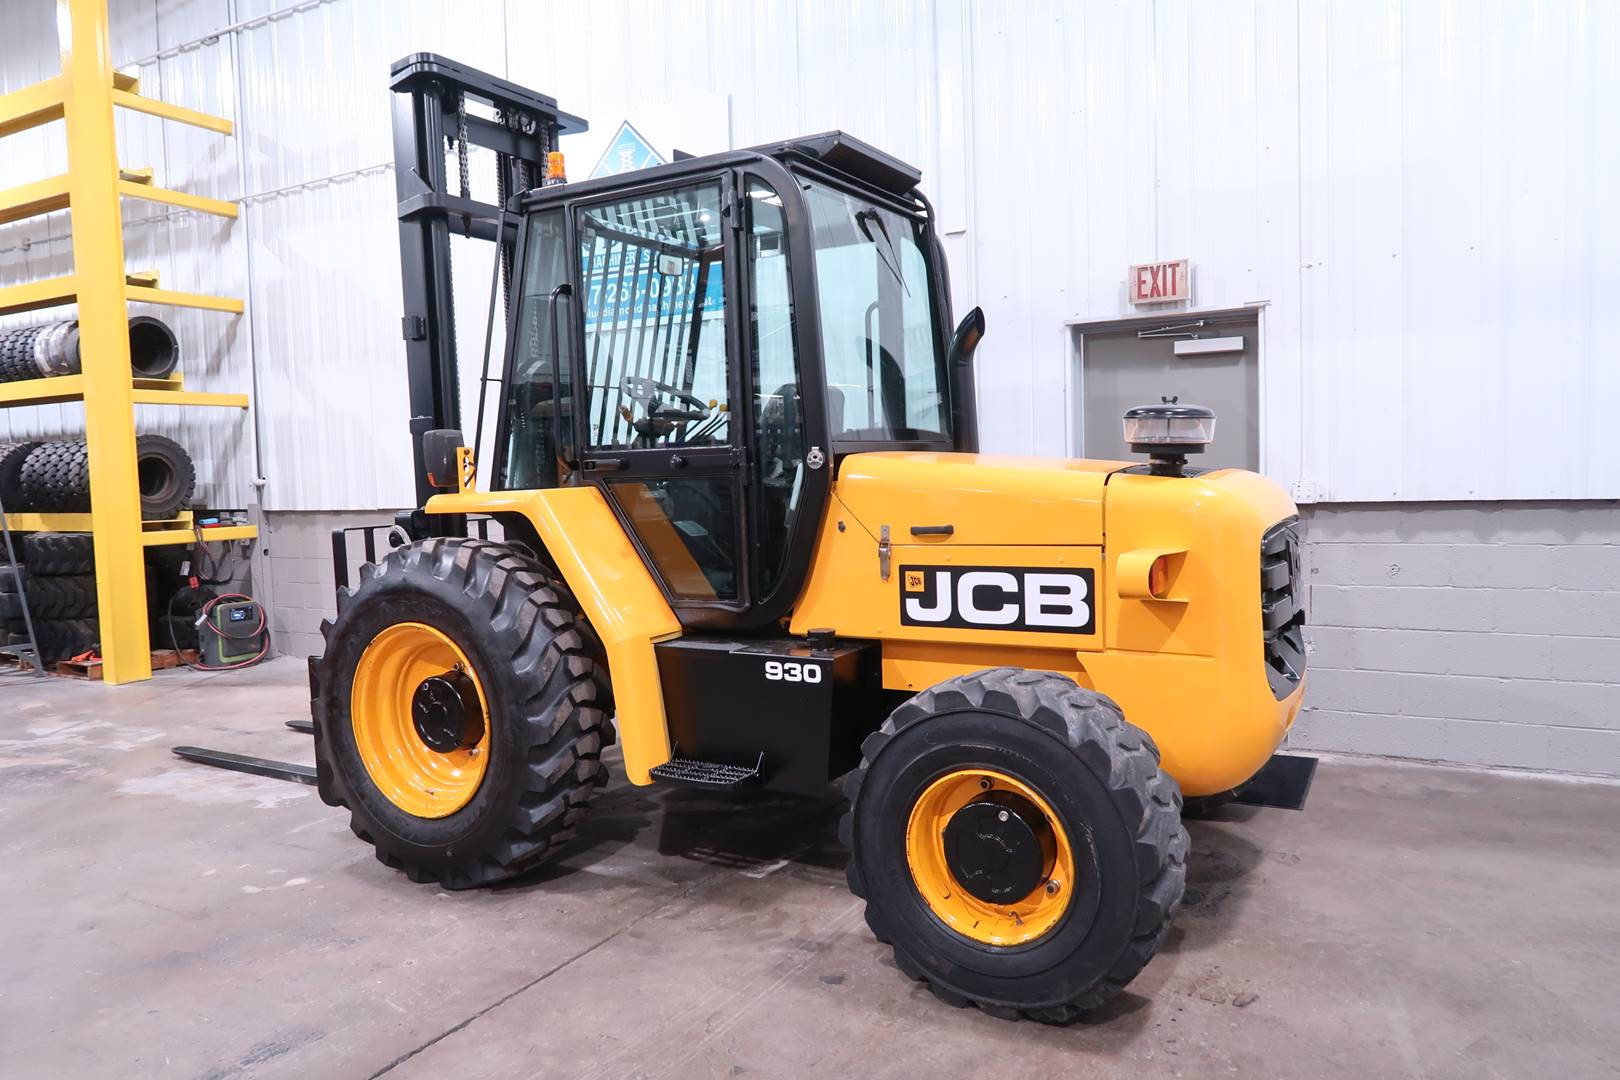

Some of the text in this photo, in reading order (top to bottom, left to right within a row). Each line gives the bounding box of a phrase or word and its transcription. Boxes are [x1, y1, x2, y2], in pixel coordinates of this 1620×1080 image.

[1137, 264, 1180, 299] EXIT
[909, 575, 922, 587] JCB
[905, 571, 1090, 628] JCB
[765, 661, 822, 683] 930
